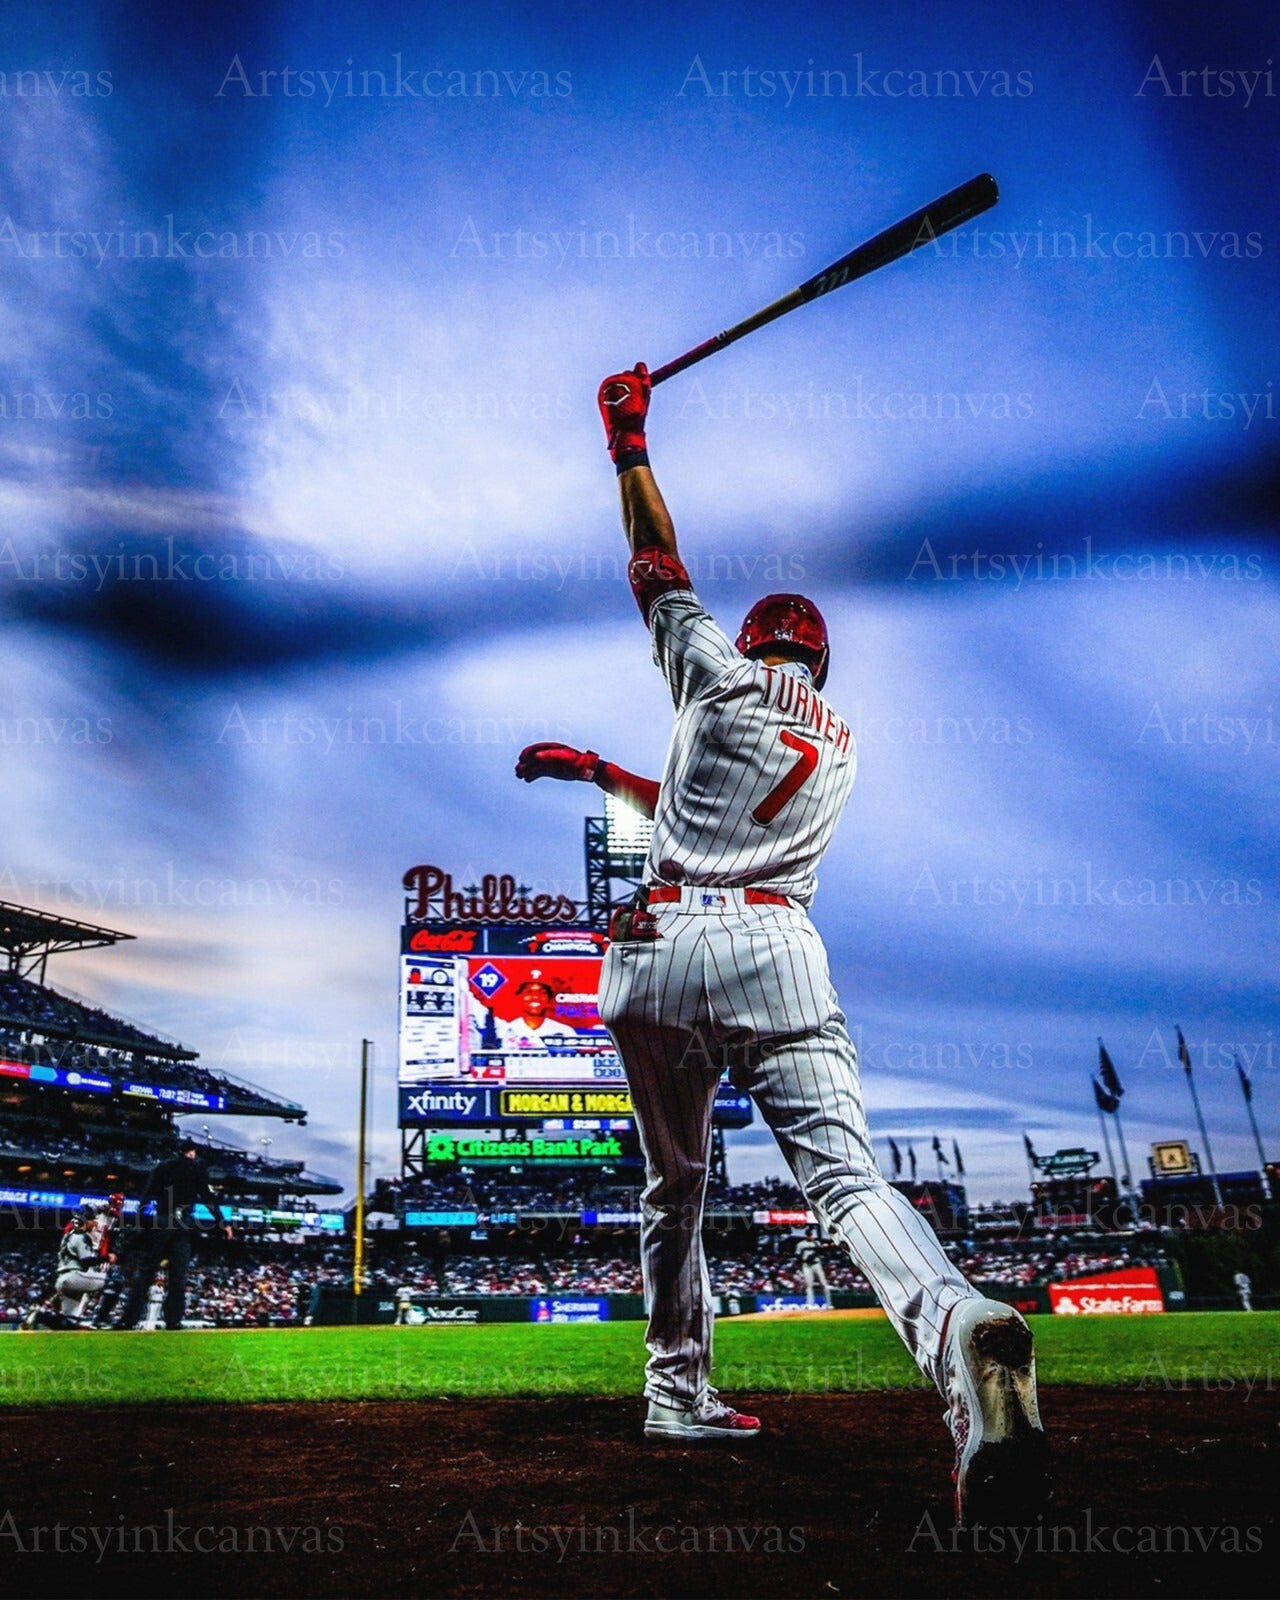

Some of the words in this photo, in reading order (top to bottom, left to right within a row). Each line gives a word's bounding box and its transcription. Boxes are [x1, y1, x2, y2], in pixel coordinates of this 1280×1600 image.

[761, 666, 851, 753] TURNER
[752, 729, 819, 827] 7
[402, 865, 577, 921] Phillies
[407, 1090, 477, 1116] xfinity
[508, 1094, 569, 1112] MORGAN
[571, 1094, 583, 1112] &
[457, 1139, 530, 1156] Citizens
[532, 1138, 579, 1155] Bank
[580, 1137, 622, 1155] Park
